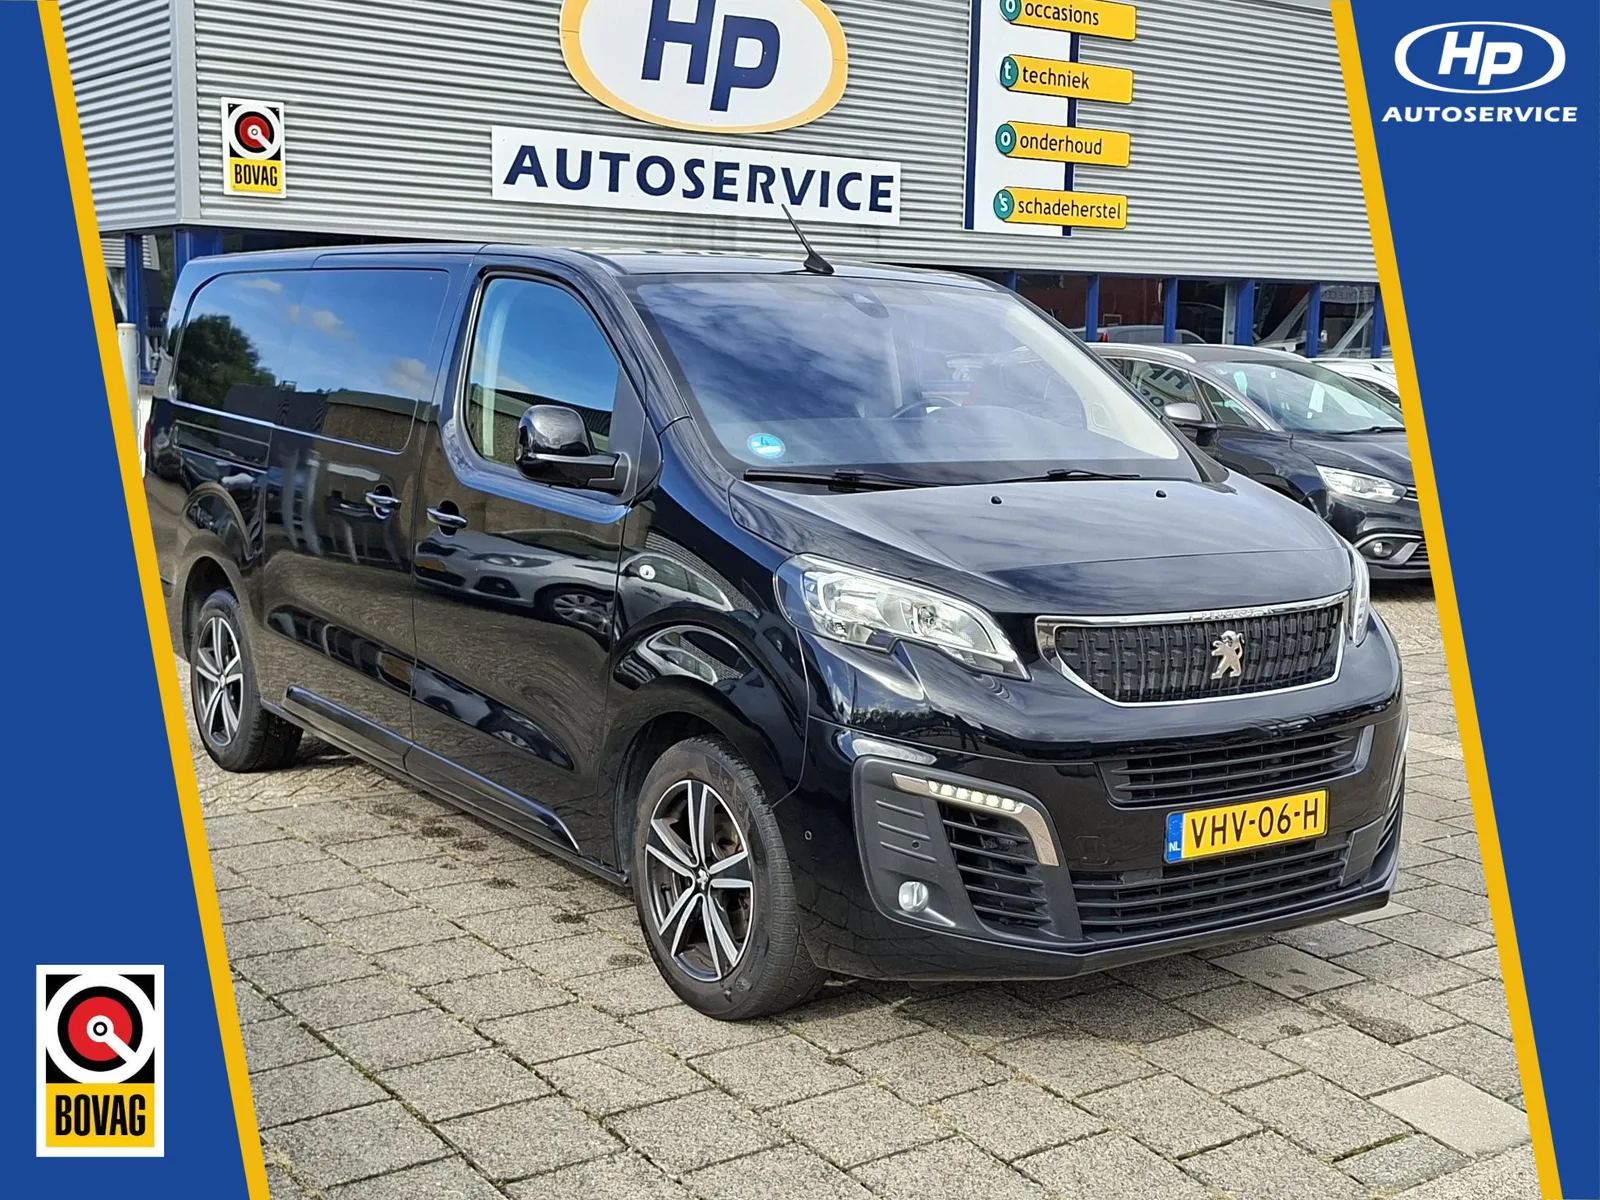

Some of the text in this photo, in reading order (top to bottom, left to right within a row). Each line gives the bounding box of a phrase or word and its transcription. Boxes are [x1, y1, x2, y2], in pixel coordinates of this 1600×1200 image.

[1025, 2, 1099, 26] occasions
[1004, 61, 1090, 90] t techniek
[1020, 133, 1102, 155] onderhoud
[234, 163, 278, 187] BOVAG
[503, 145, 894, 213] AUTOSERVICE
[1018, 197, 1121, 220] schadeherstel
[1168, 798, 1319, 852] NL VHV-06-H
